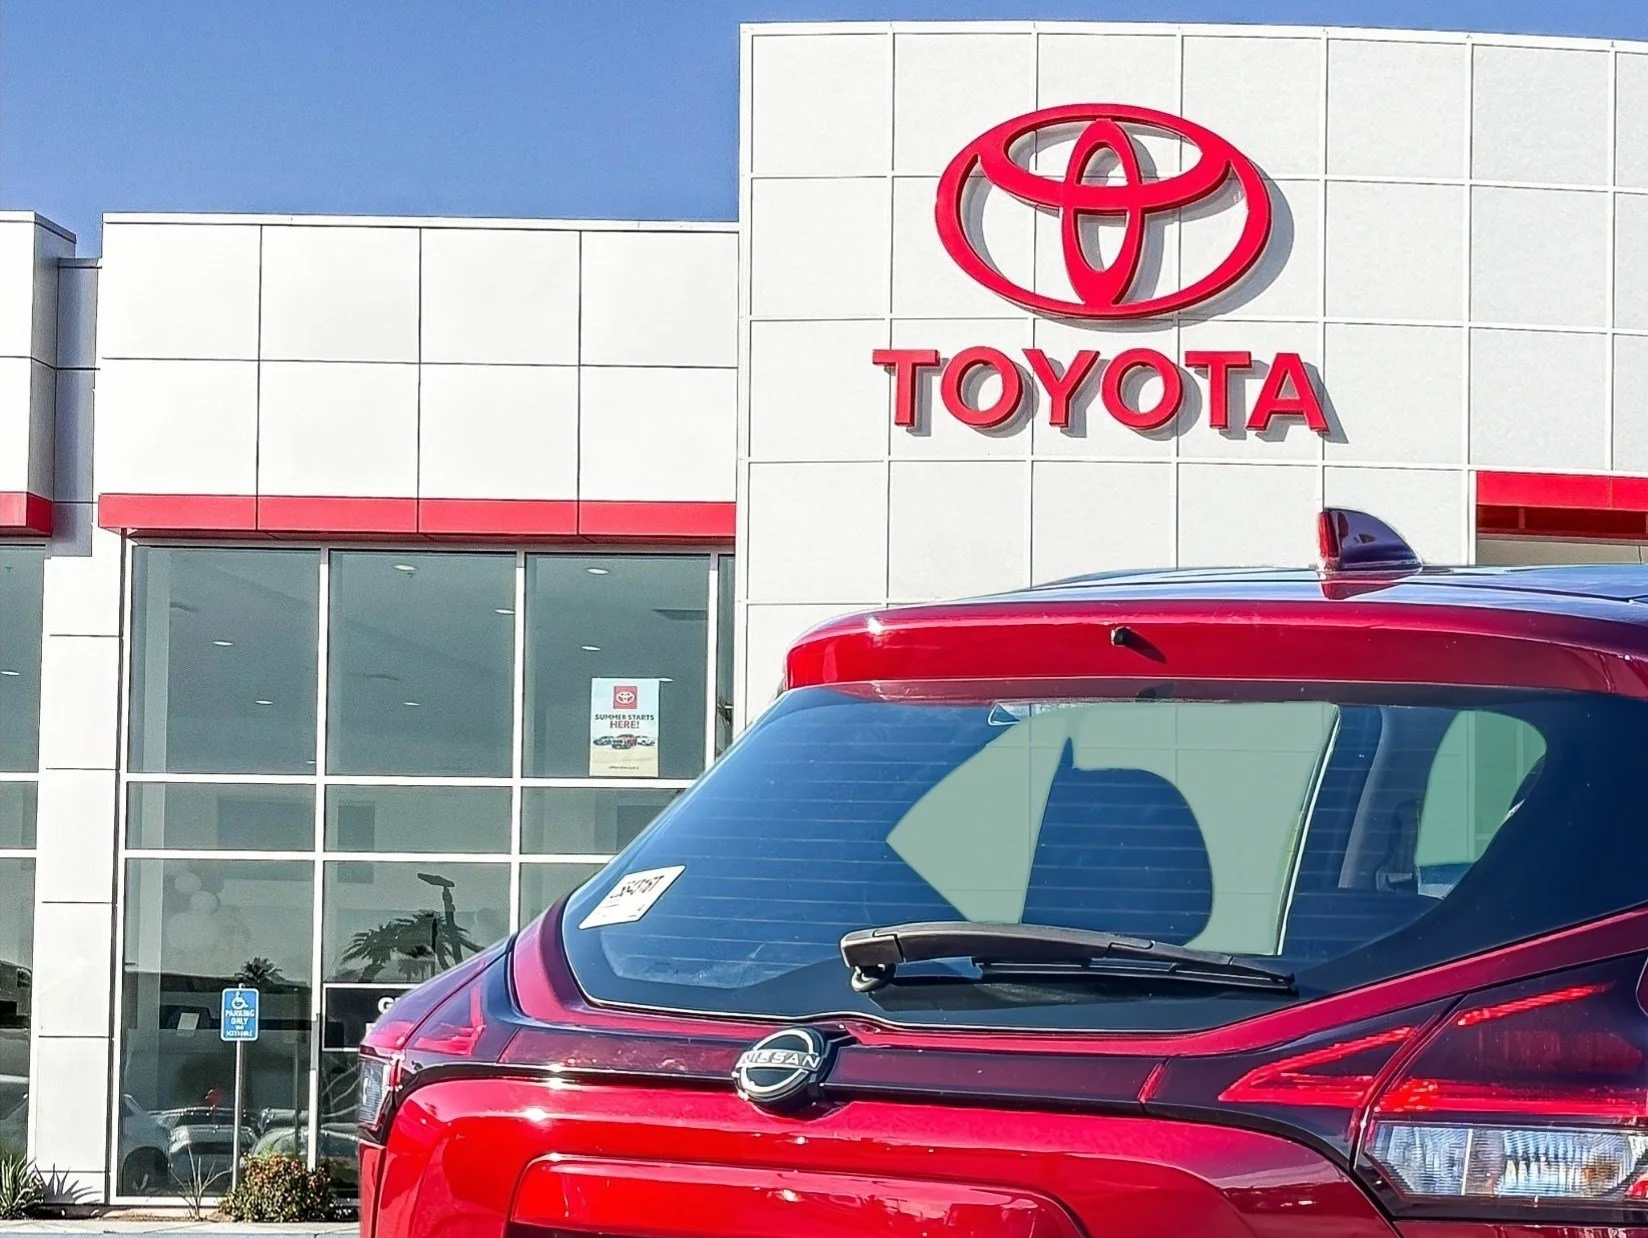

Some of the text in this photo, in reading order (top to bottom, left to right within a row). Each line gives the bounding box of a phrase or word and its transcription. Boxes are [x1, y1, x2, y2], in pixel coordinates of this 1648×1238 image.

[872, 345, 1330, 433] TOYOTA
[609, 721, 640, 729] HERE!
[225, 1009, 255, 1017] PARKING
[230, 1017, 249, 1025] ONLY
[741, 1050, 821, 1069] NISSAN
